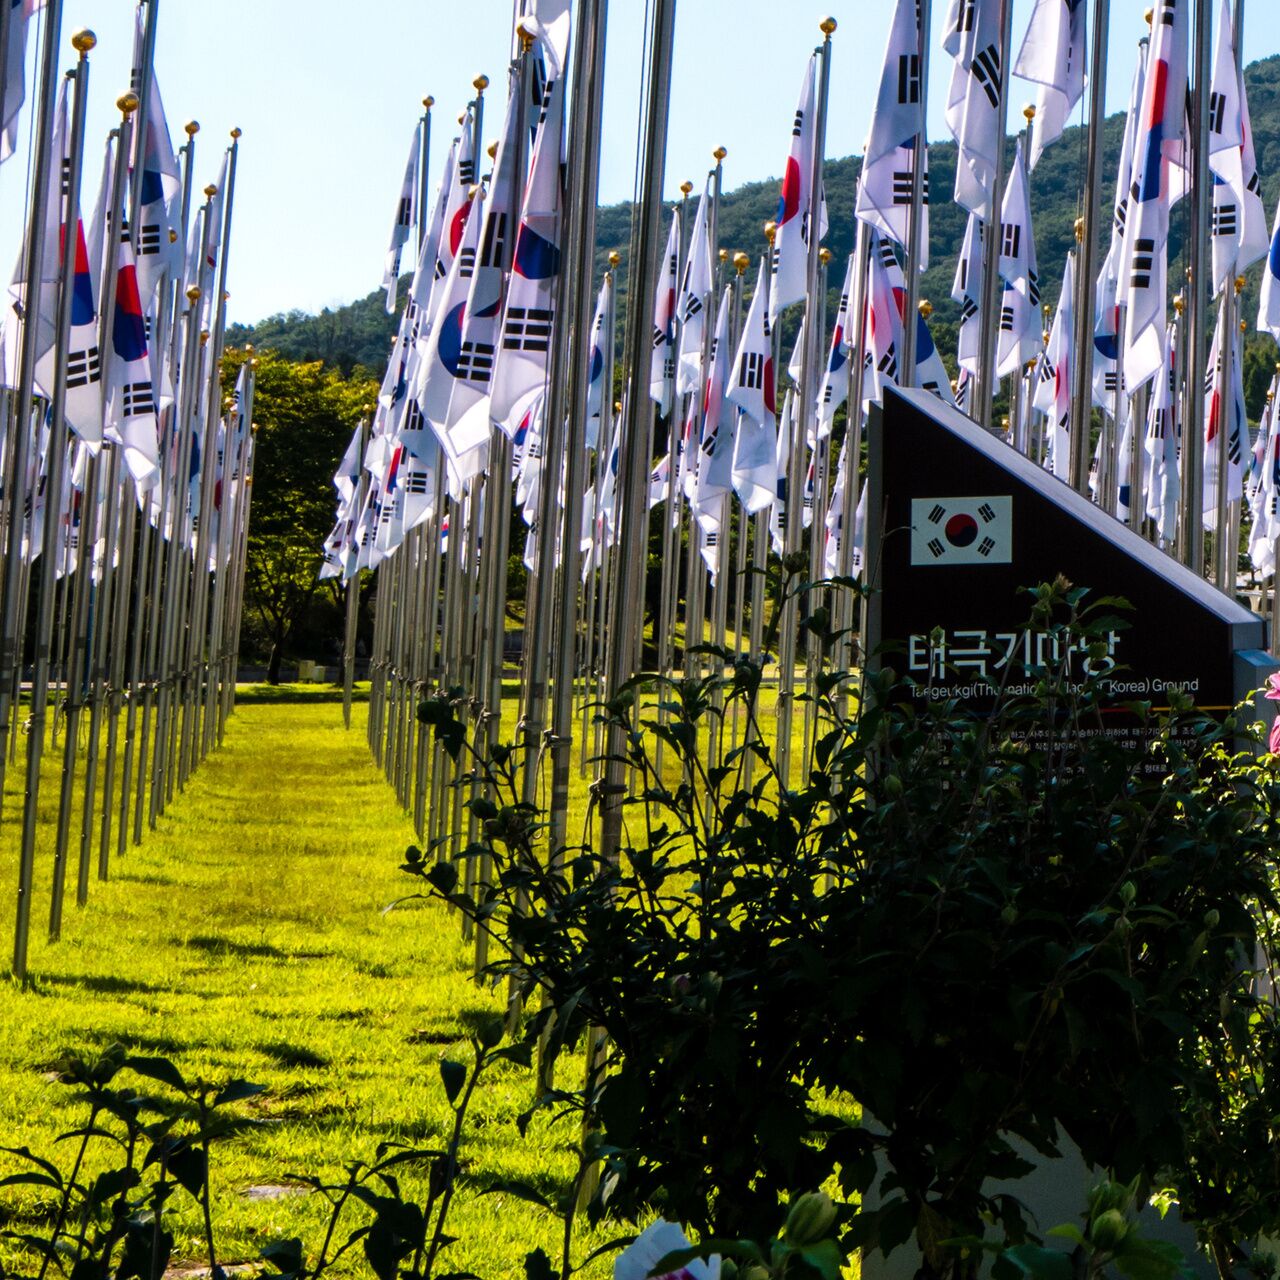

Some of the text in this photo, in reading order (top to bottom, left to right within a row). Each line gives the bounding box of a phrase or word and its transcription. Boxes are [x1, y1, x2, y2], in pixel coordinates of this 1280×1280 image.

[909, 629, 1121, 679] 태극기마당
[1110, 677, 1150, 694] Korea)
[1152, 677, 1199, 693] Ground
